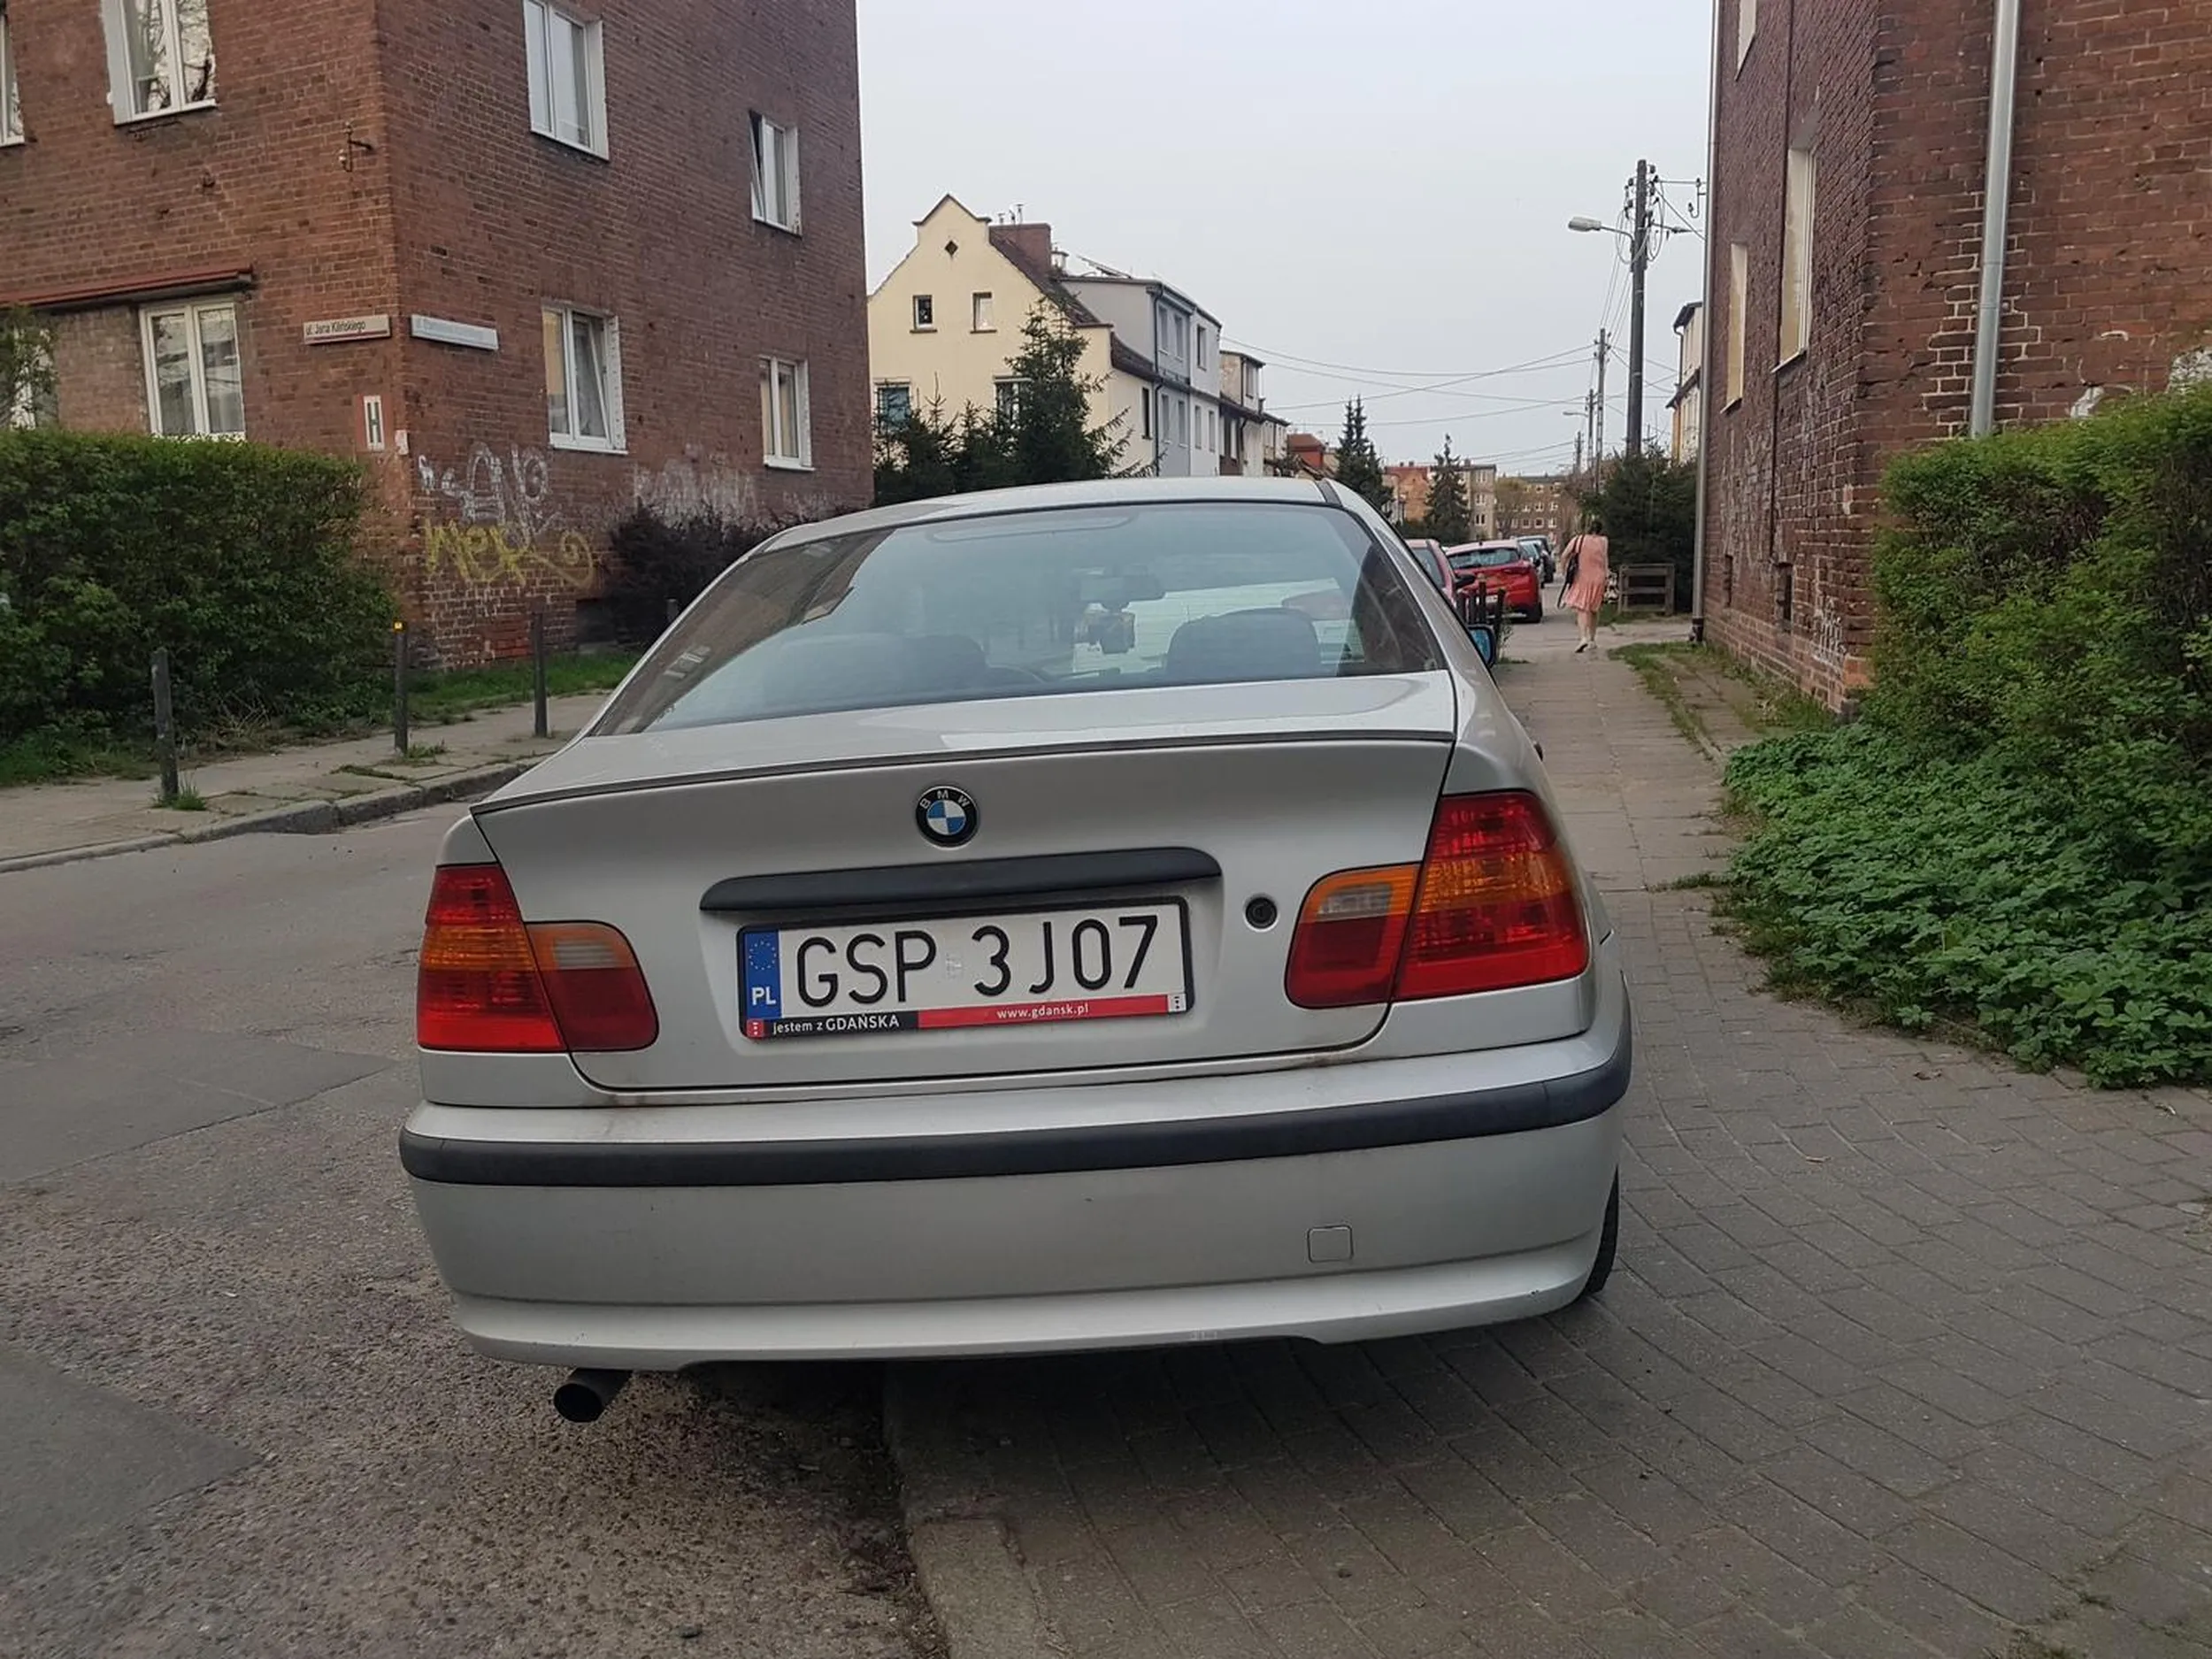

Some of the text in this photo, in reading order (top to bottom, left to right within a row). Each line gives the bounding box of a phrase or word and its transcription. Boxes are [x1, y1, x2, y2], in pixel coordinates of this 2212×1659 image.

[367, 402, 382, 443] H
[919, 789, 971, 809] BMW
[796, 914, 1158, 1008] GSP 3J07
[752, 987, 777, 1006] PL
[997, 1002, 1089, 1022] www.gdansk.pl
[772, 1013, 900, 1035] jestem z GDAŃSKA
